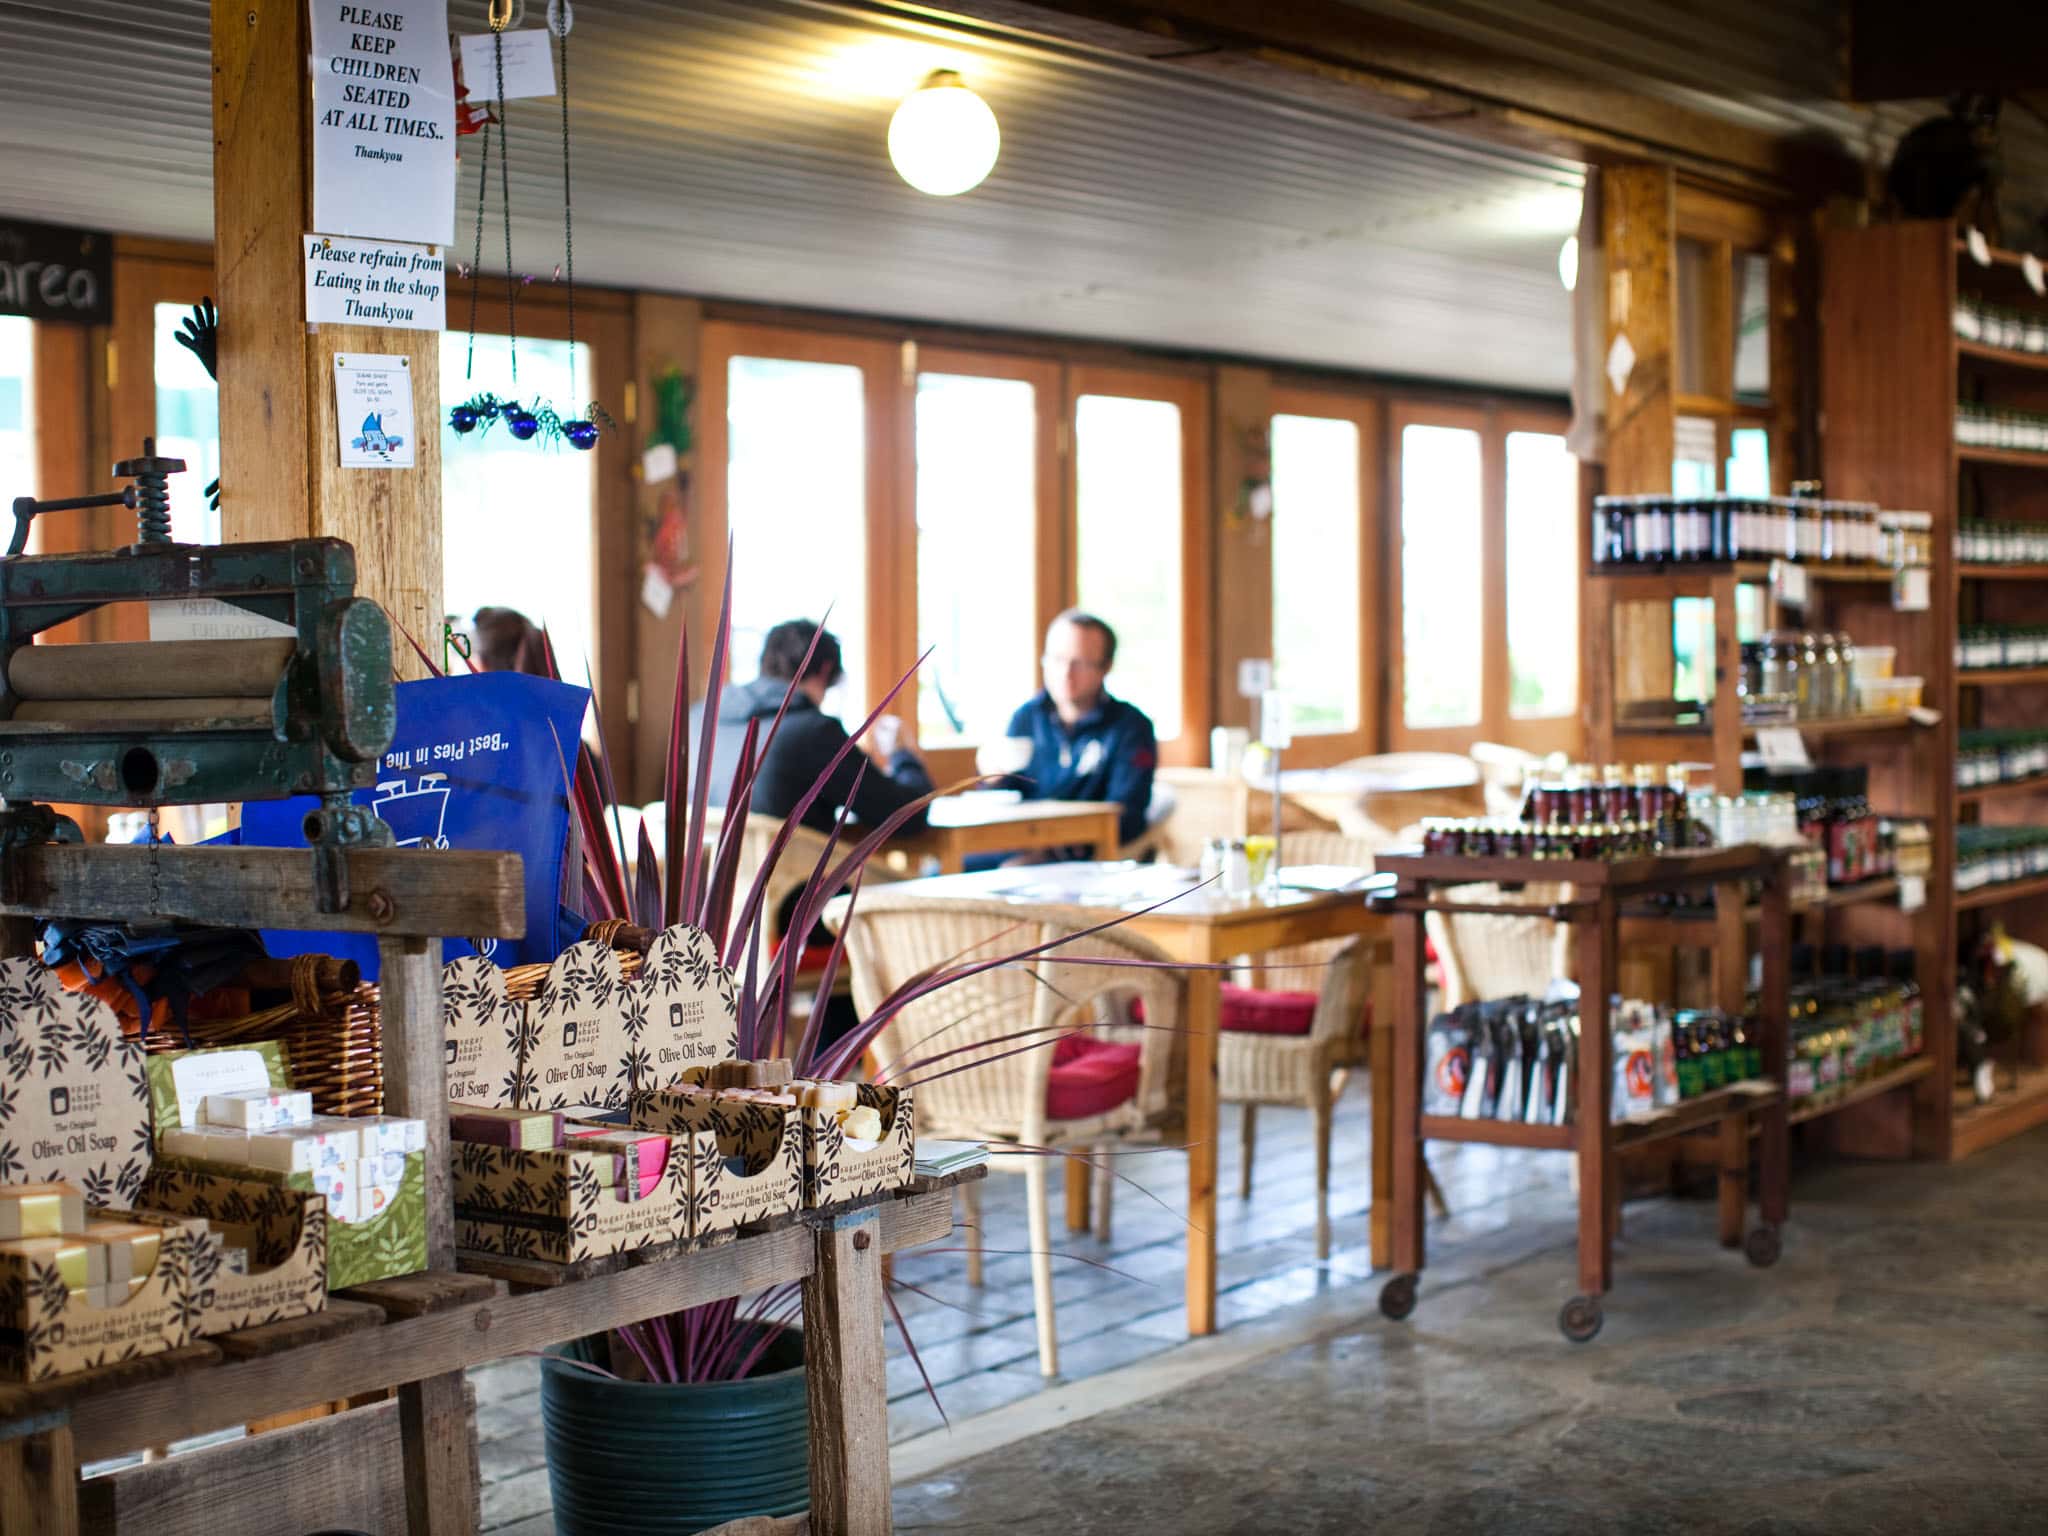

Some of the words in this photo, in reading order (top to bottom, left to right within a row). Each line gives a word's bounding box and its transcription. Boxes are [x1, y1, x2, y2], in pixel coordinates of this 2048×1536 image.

[340, 5, 404, 32] PLEASE
[351, 33, 396, 55] KEEP
[330, 56, 421, 85] CHILDREN
[343, 84, 410, 110] SEATED
[321, 109, 345, 127] AT
[345, 112, 378, 132] ALL
[354, 145, 403, 164] Thankyou
[309, 242, 356, 264] Please
[359, 249, 406, 270] refrain
[408, 253, 442, 274] from
[314, 270, 362, 295] Eating
[365, 274, 380, 292] in
[383, 276, 405, 295] the
[408, 279, 440, 302] shop
[345, 298, 414, 324] Thankyou
[385, 751, 411, 770] The
[415, 746, 429, 765] in
[433, 741, 465, 761] Pies
[563, 1052, 573, 1060] The
[659, 1047, 680, 1064] Olive
[682, 1043, 696, 1060] Oil
[697, 1042, 717, 1058] Soap
[546, 1067, 568, 1084] Olive
[571, 1062, 585, 1079] Oil
[587, 1062, 607, 1078] Soap
[449, 1082, 464, 1099] Oil
[467, 1081, 489, 1097] Soap
[32, 1140, 63, 1160] Olive
[67, 1134, 86, 1154] Oil
[89, 1133, 117, 1152] Soap
[862, 1168, 876, 1181] Olive
[887, 1163, 898, 1174] Soap
[745, 1196, 760, 1208] Olive
[773, 1189, 786, 1200] Soap
